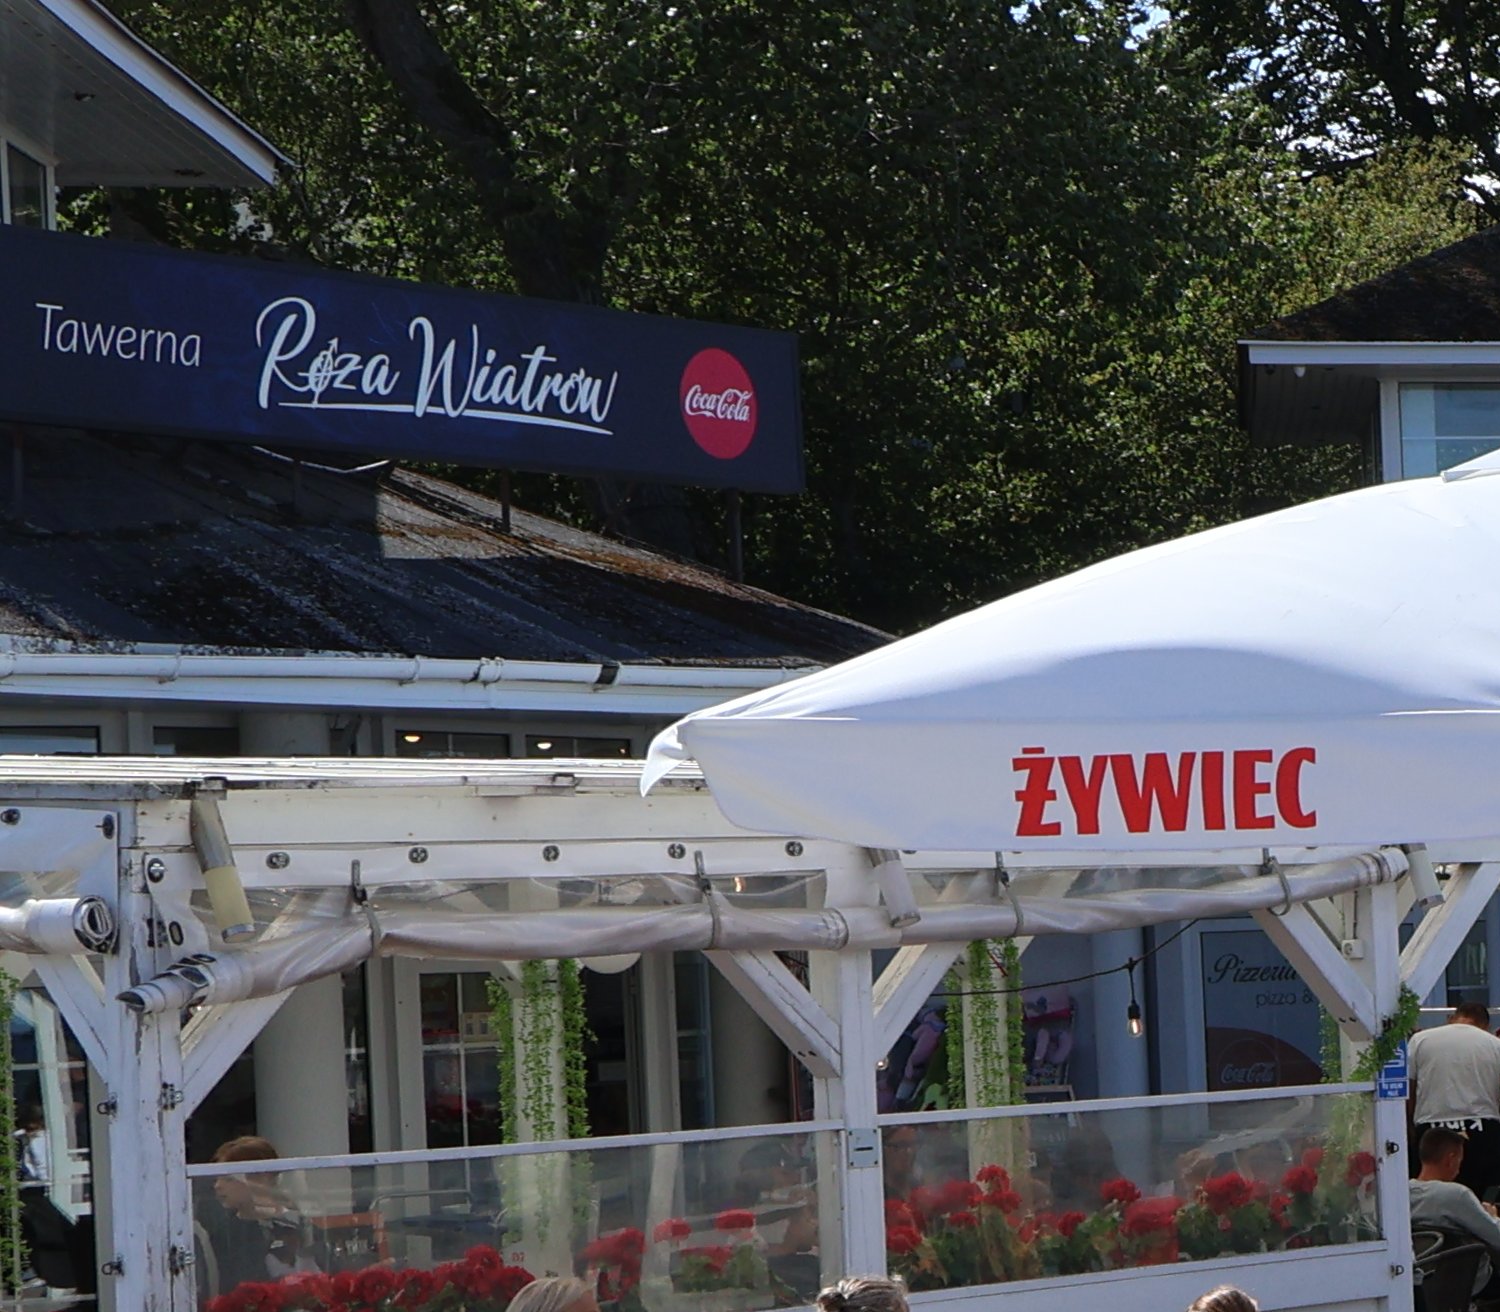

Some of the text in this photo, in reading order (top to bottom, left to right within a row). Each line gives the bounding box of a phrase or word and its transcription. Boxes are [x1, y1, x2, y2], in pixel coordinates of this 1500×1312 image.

[36, 303, 202, 368] Tawerna
[685, 385, 752, 421] Coca-Cola
[1011, 746, 1317, 837] ŻYWIEC
[1255, 991, 1296, 1009] pizza
